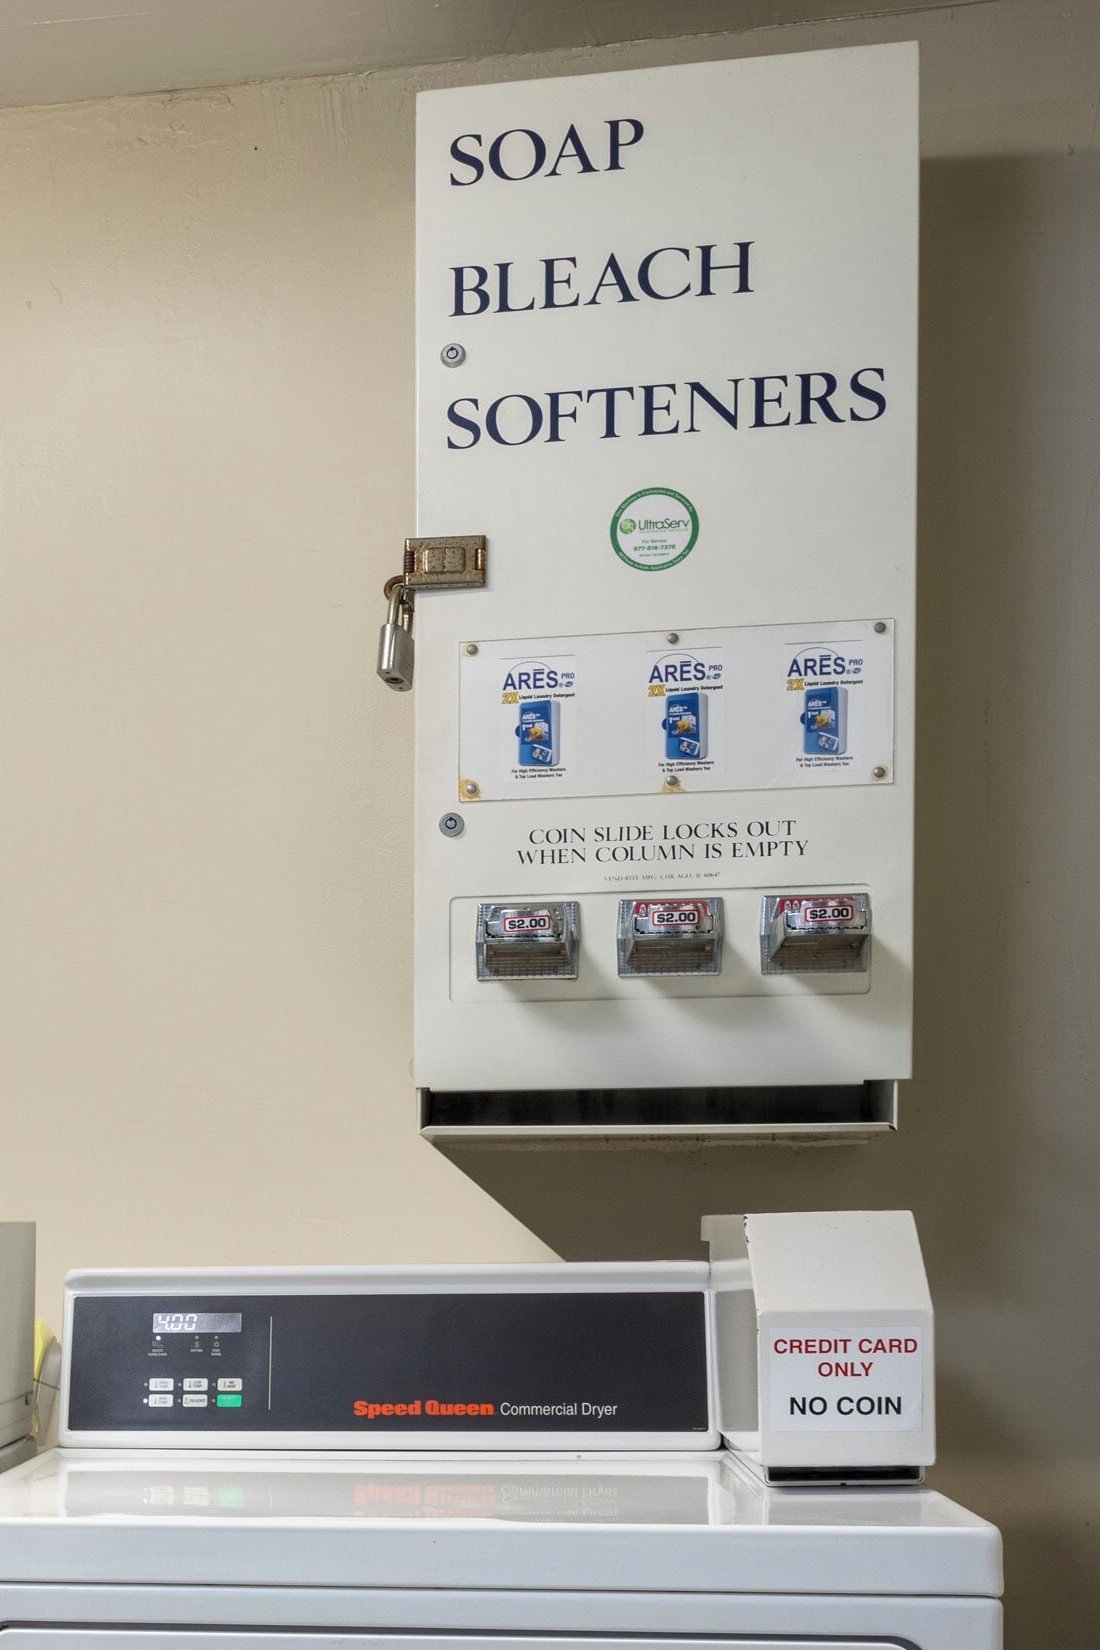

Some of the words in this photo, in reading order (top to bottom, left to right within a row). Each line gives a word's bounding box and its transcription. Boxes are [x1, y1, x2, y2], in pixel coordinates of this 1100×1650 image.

[449, 118, 645, 186] SOAP
[448, 241, 755, 318] BLEACH
[446, 367, 887, 450] SOFTENERS
[638, 518, 690, 531] UltraServ
[848, 658, 863, 666] PRO
[560, 672, 575, 680] PRO
[648, 684, 666, 697] 2X
[786, 678, 805, 691] 2X
[501, 691, 520, 704] 2X
[529, 828, 586, 845] COIN
[594, 825, 653, 842] SLIDE
[663, 822, 738, 840] LOCKS
[746, 820, 797, 837] OUT
[517, 847, 586, 865] WHEN
[595, 844, 695, 863] COLUMN
[705, 843, 722, 859] IS
[732, 840, 808, 858] EMPTY
[656, 911, 696, 924] $2.00
[809, 907, 850, 920] $2.00
[508, 917, 547, 930] $2.00
[773, 1338, 852, 1354] CREDIT
[858, 1338, 918, 1354] CARD
[817, 1361, 874, 1377] ONLY
[353, 1400, 421, 1419] Speed
[425, 1400, 495, 1416] Queen
[500, 1402, 578, 1416] Commercial
[582, 1402, 618, 1419] Dryer
[789, 1396, 828, 1416] NO
[836, 1396, 902, 1416] COIN
